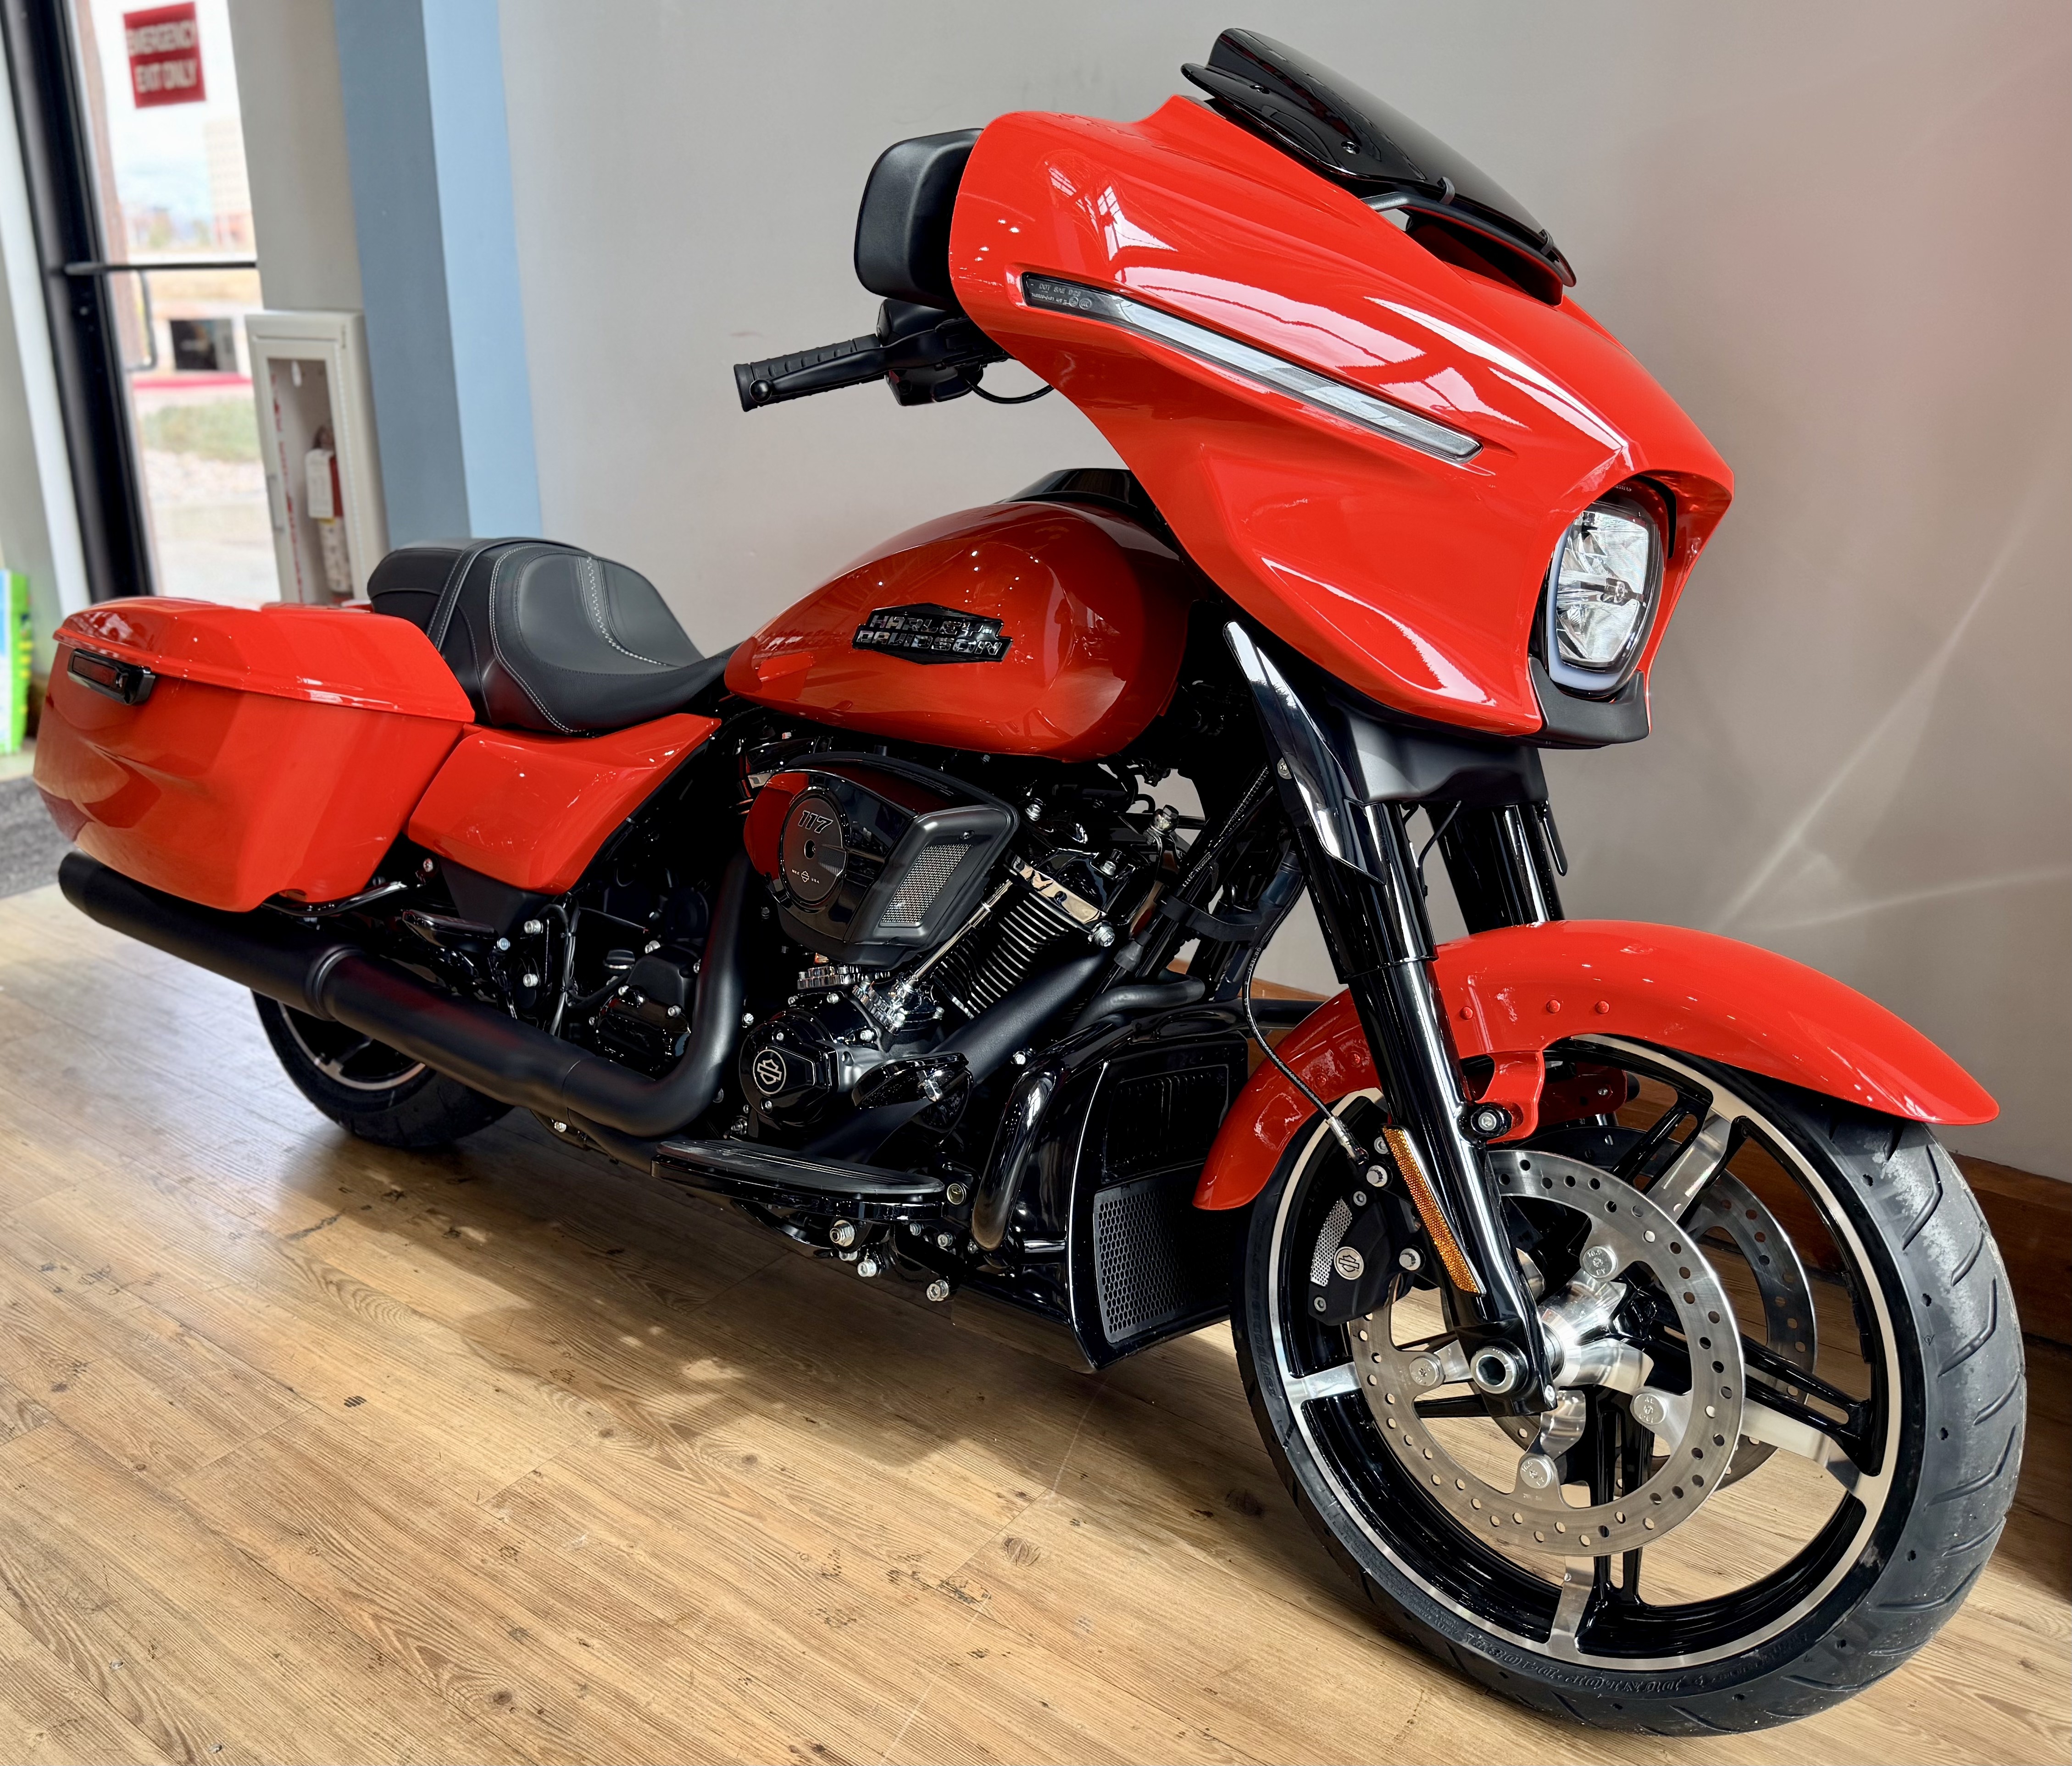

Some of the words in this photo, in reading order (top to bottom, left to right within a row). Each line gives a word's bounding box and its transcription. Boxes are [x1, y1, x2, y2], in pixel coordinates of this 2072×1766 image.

[856, 630, 1002, 655] DAVIDSON
[798, 810, 833, 834] 117
[1565, 1675, 1683, 1693] DUNLOP
